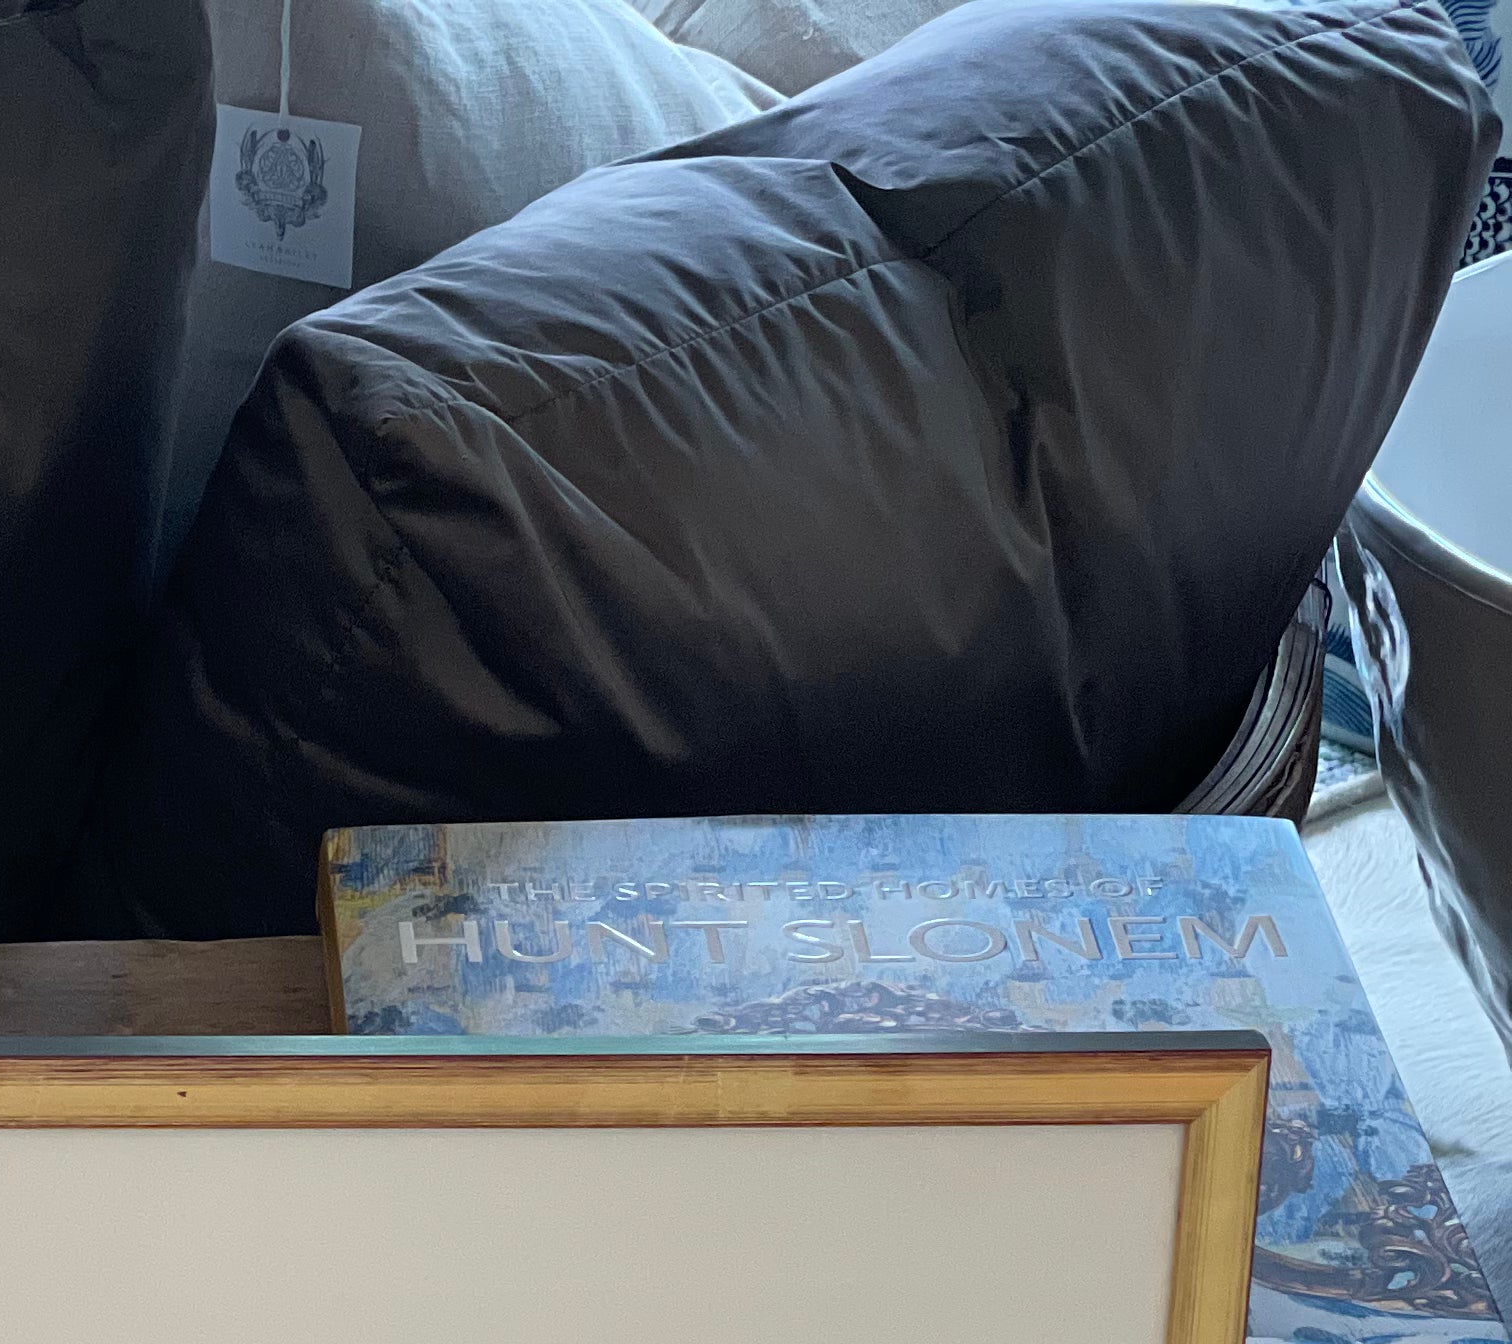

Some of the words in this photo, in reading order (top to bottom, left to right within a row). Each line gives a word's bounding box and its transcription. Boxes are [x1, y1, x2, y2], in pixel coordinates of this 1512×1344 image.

[488, 882, 597, 902] THE
[614, 881, 855, 901] SPIRITED
[876, 880, 1075, 900] HOMES
[1089, 877, 1164, 898] OF
[399, 920, 746, 964] HUNT
[781, 917, 1288, 963] SLONEM
